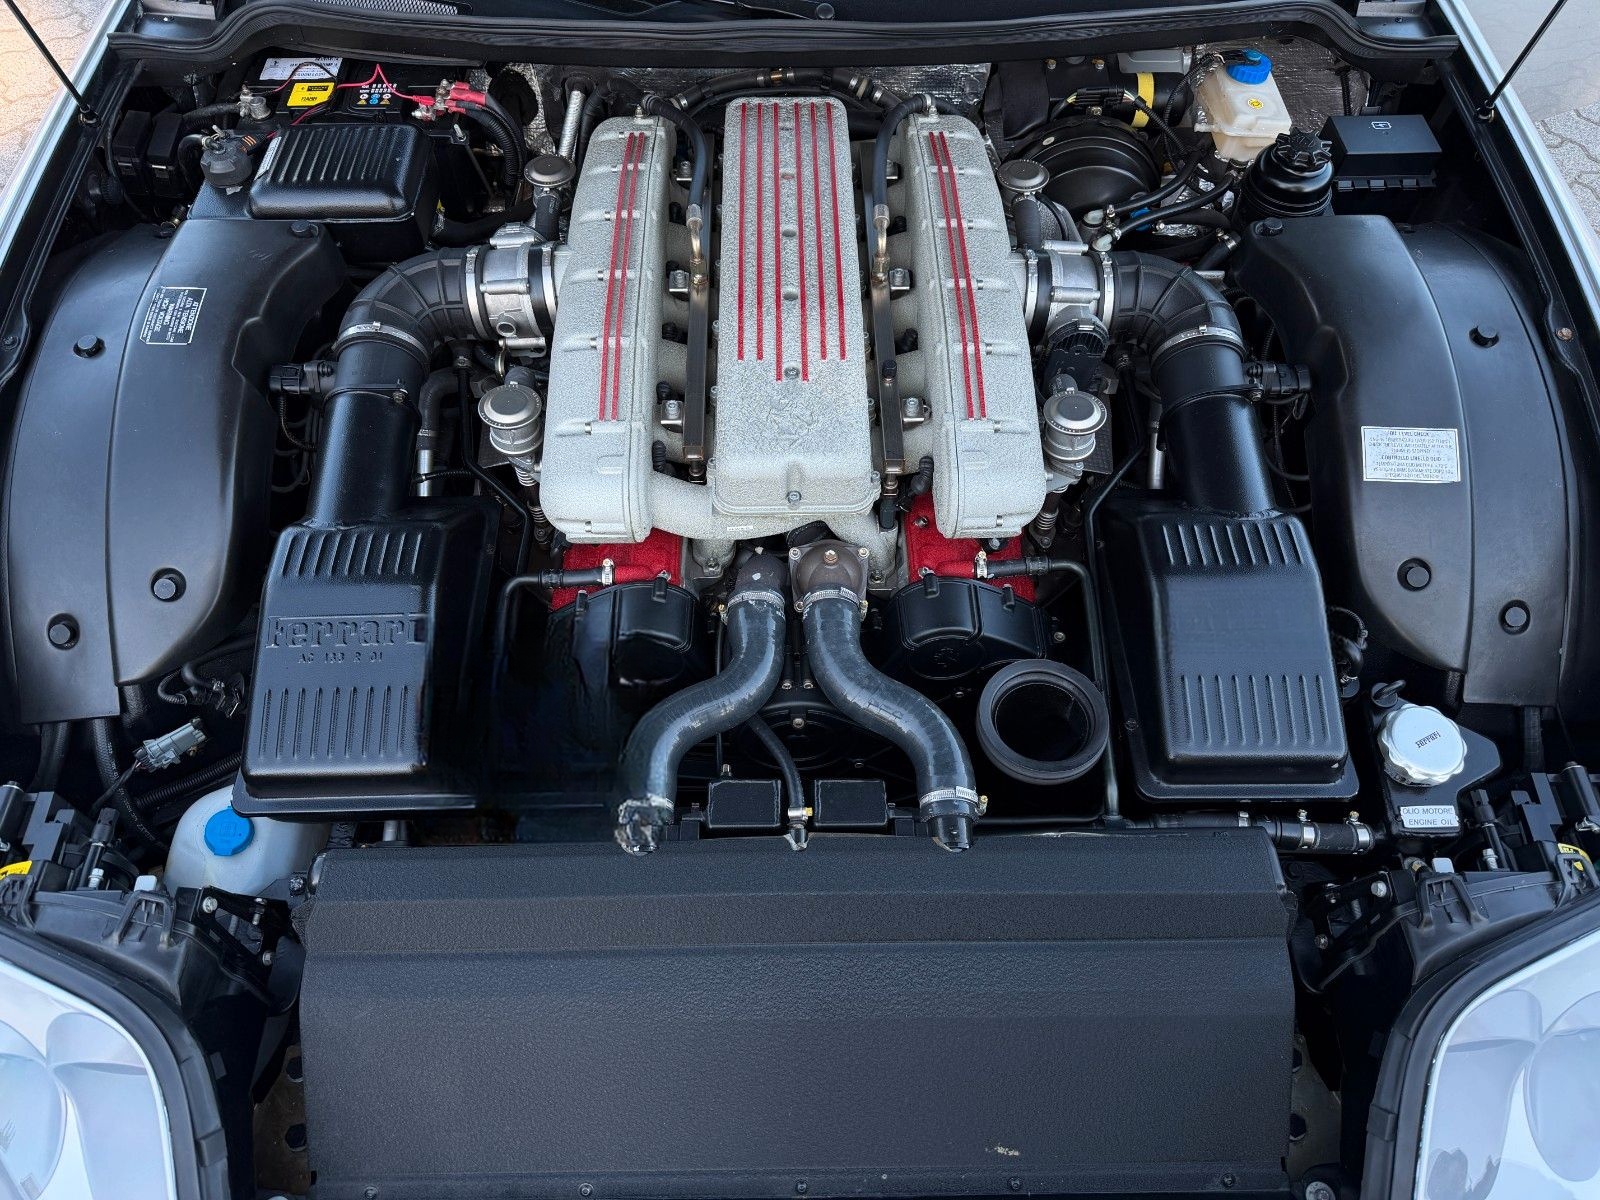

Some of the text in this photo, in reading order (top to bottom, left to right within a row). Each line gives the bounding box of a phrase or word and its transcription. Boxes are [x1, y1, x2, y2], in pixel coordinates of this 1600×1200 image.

[184, 297, 194, 309] ALTA
[177, 309, 190, 334] TENSIONE
[185, 301, 199, 331] ATTENZIONE
[1402, 807, 1454, 815] OLIO MOTORE
[1408, 818, 1453, 826] ENGINE OIL
